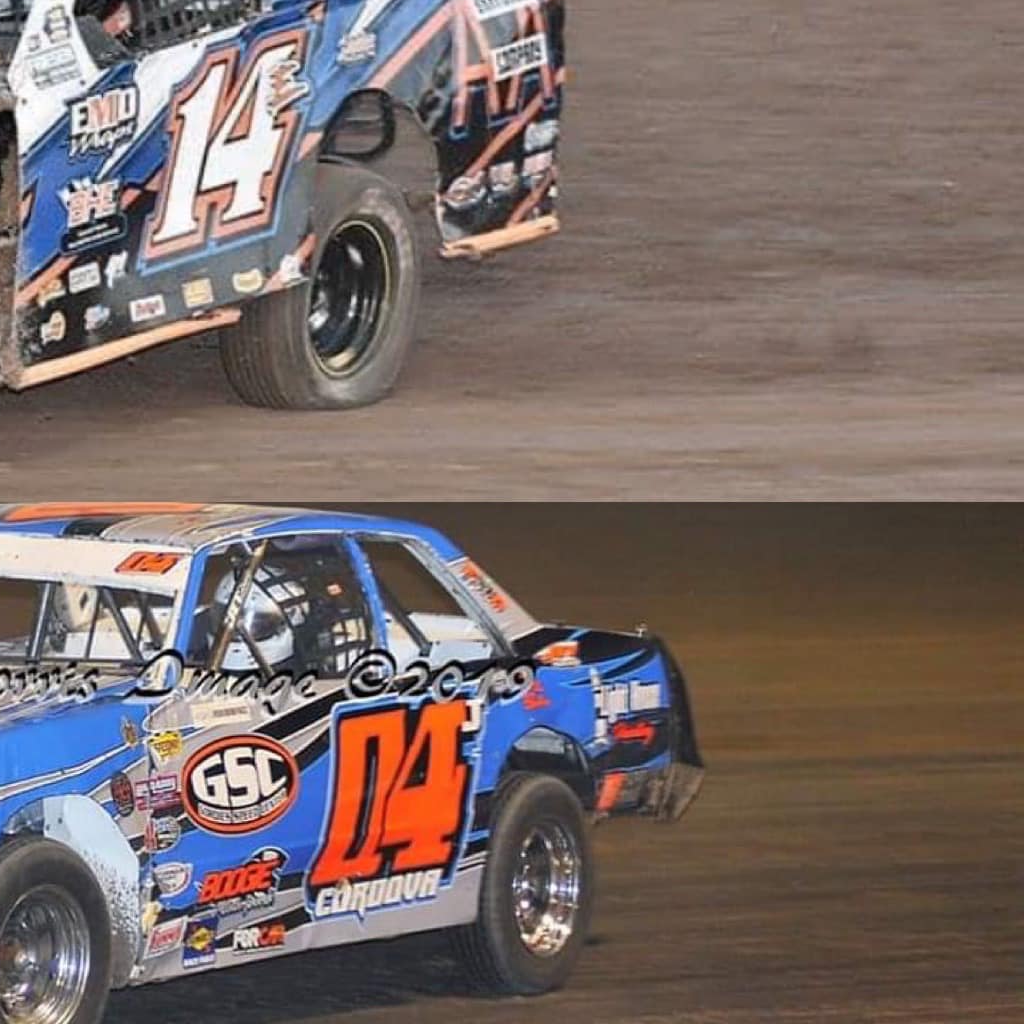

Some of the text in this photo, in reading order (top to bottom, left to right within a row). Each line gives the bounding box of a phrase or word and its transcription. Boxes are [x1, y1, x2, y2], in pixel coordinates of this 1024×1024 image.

[148, 41, 298, 248] 14
[190, 746, 288, 808] GSC
[310, 700, 467, 888] 04
[315, 868, 444, 916] CORDOVA
